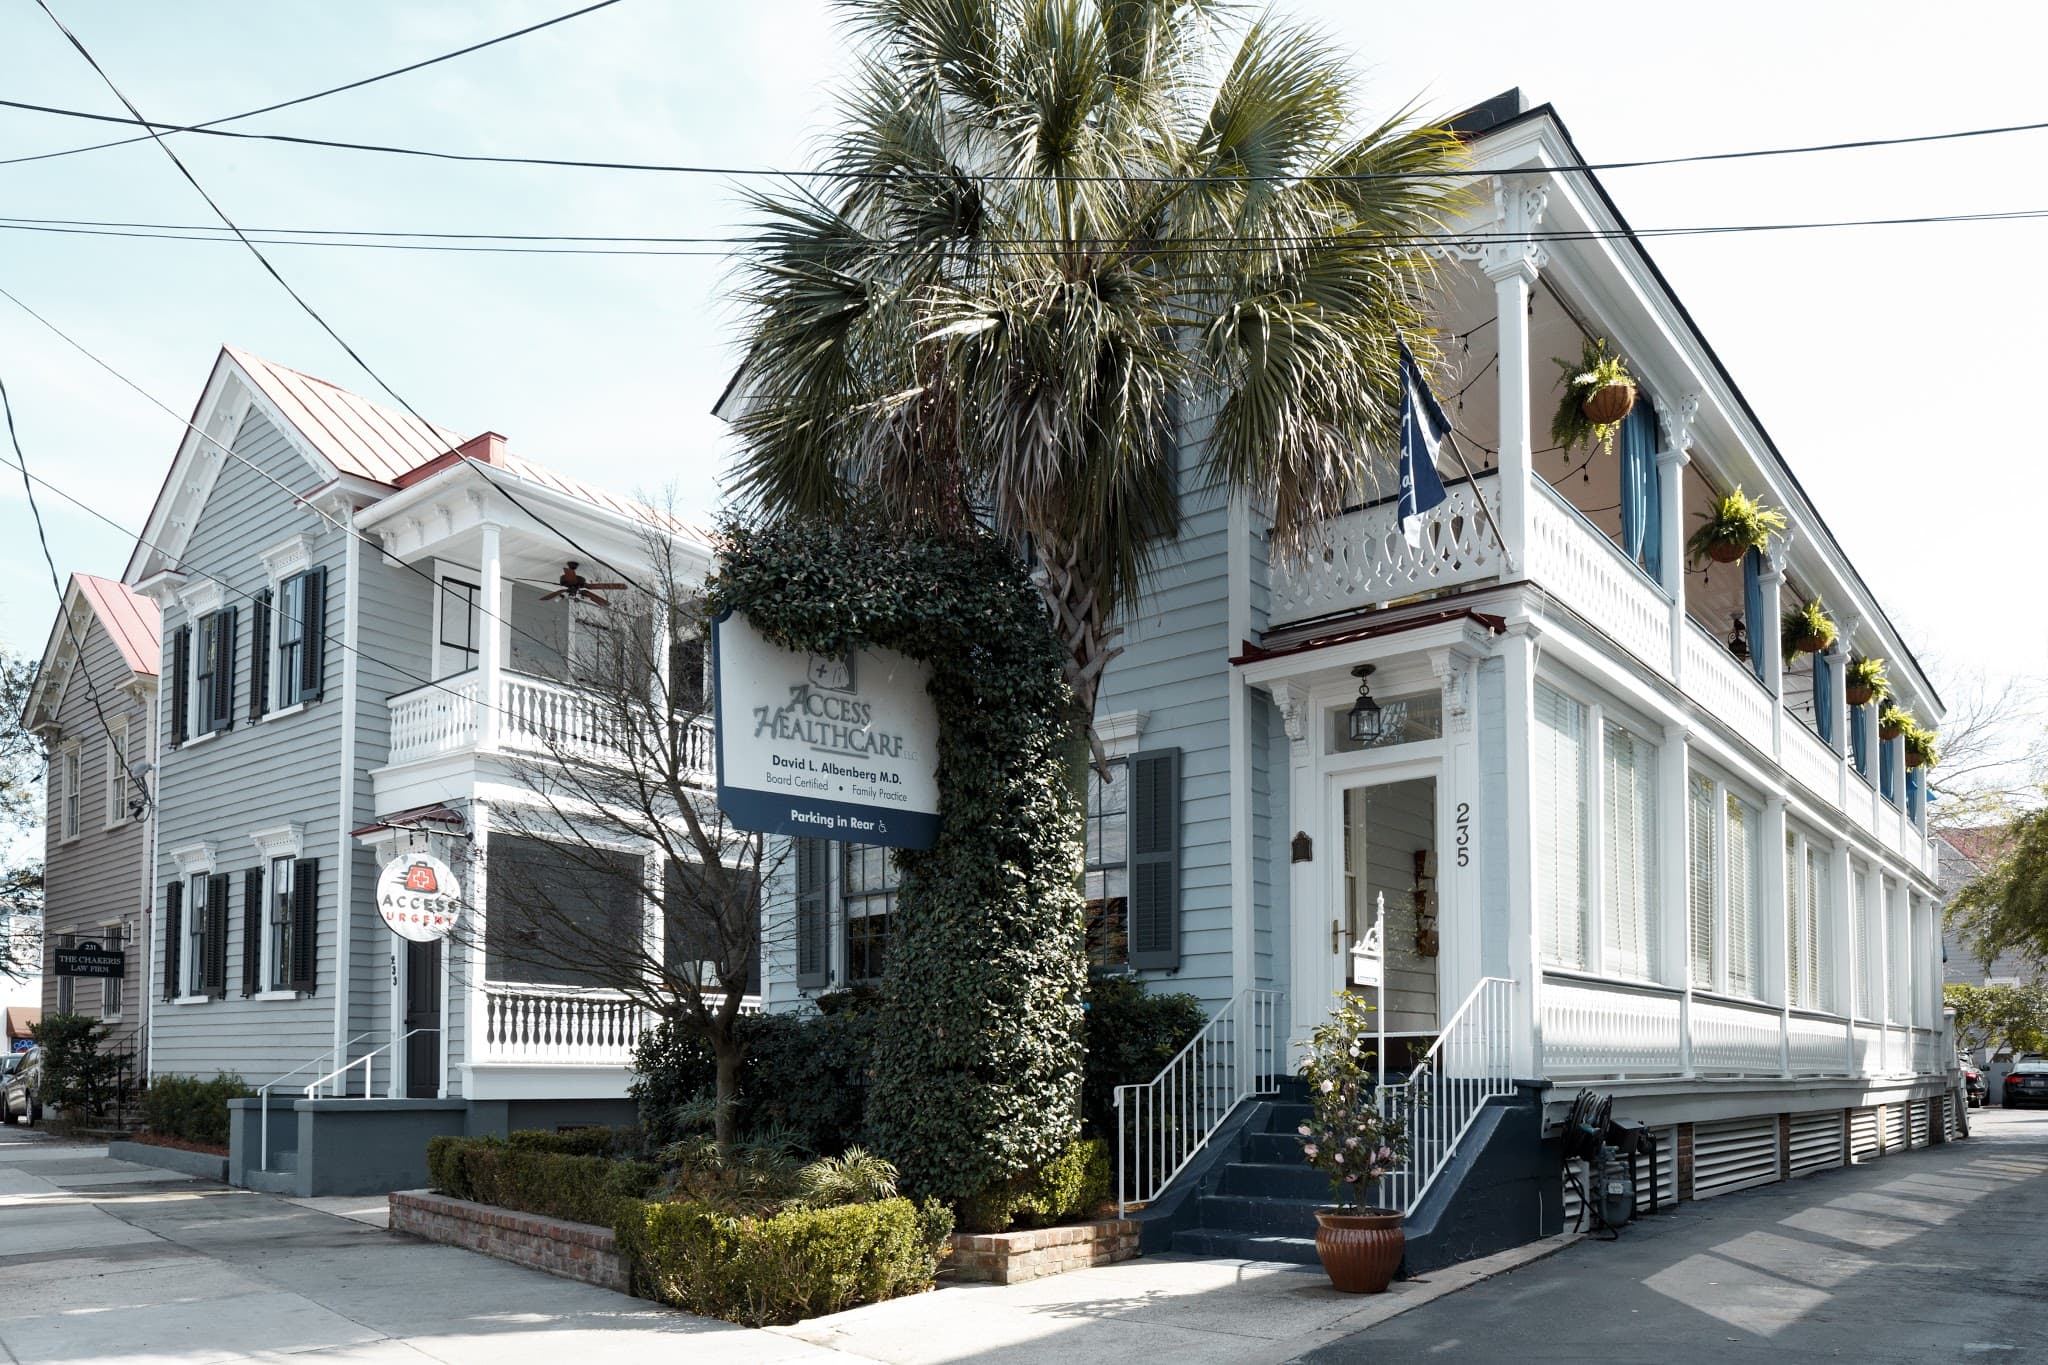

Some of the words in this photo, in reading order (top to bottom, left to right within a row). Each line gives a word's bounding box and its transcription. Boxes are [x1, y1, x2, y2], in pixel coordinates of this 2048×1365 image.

[784, 684, 871, 726] ACCESS
[772, 755, 805, 769] David
[809, 760, 817, 772] L.
[821, 762, 876, 783] Albenberg
[880, 771, 902, 784] M.D.
[766, 772, 792, 786] Board
[794, 776, 829, 791] Certified
[852, 784, 877, 802] Family
[880, 789, 908, 802] Practice
[791, 809, 834, 828] Parking
[837, 815, 848, 827] in
[850, 817, 875, 831] Rear
[1456, 802, 1470, 867] 235
[382, 893, 457, 914] ACCESS
[58, 955, 78, 963] THE
[71, 964, 88, 972] LAW
[90, 965, 109, 973] FIRM
